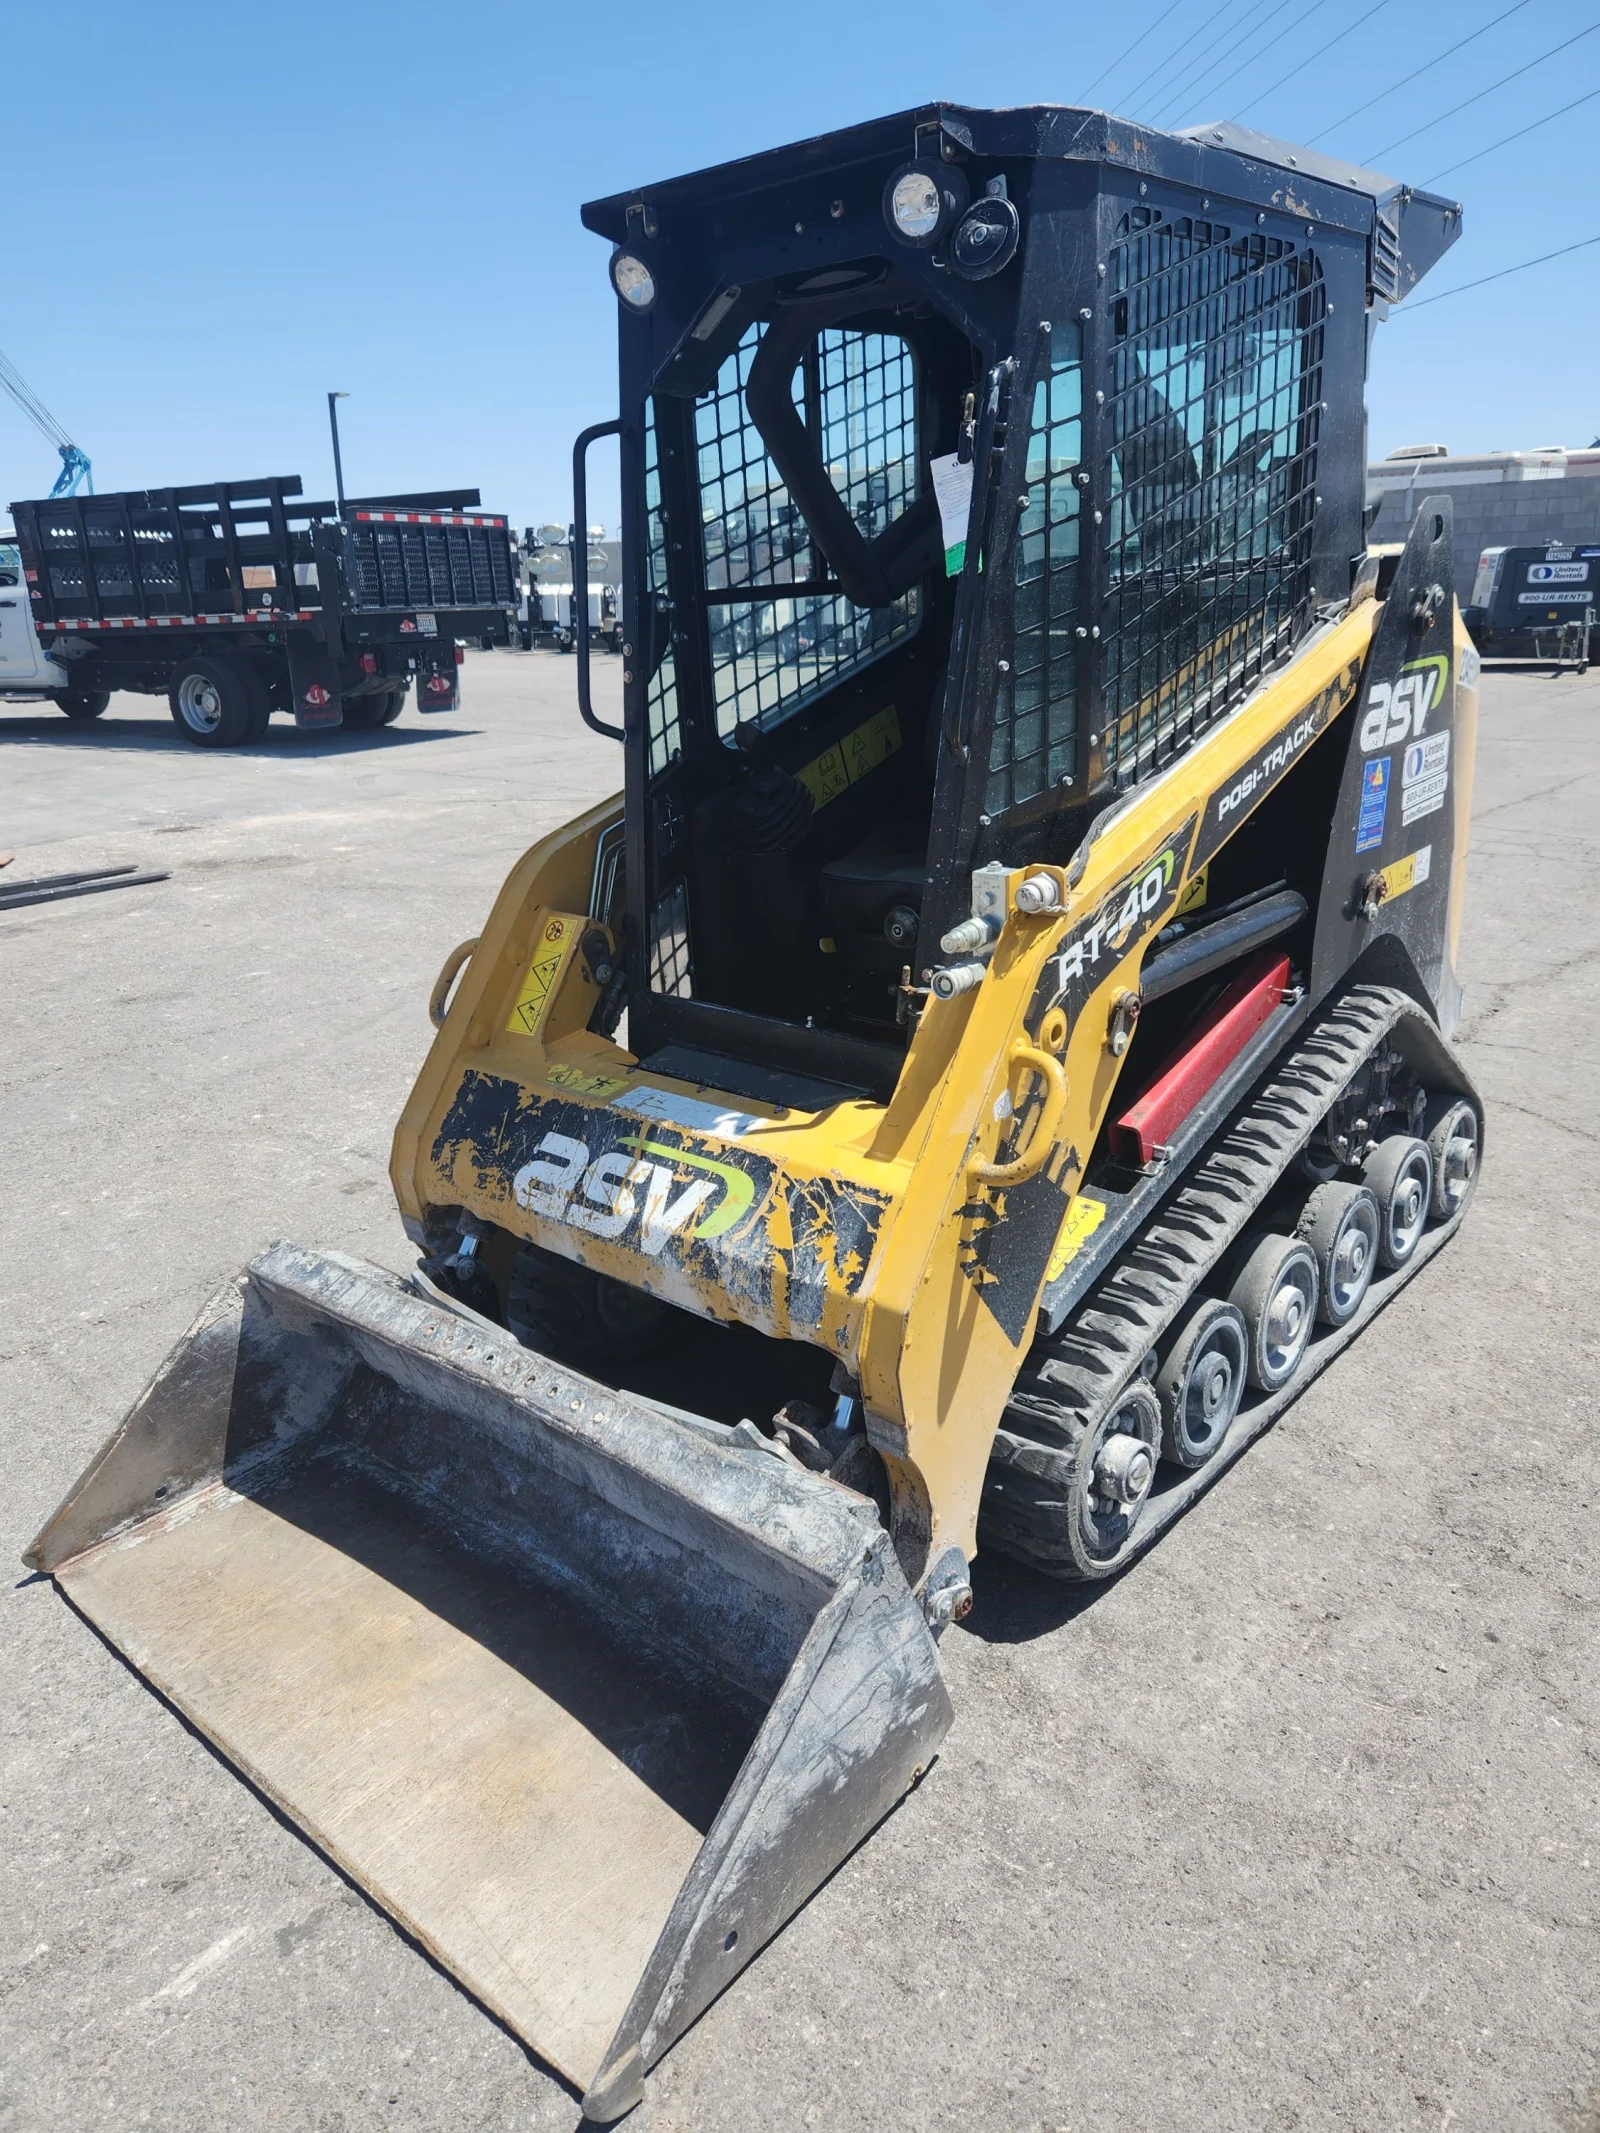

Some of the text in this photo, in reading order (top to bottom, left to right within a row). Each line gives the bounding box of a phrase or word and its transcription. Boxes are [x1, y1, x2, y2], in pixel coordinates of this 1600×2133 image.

[1553, 572, 1584, 580] Rentals
[1554, 565, 1583, 573] United
[1424, 737, 1446, 758] United
[1218, 713, 1315, 822] POSI-TRACK
[1423, 754, 1446, 773] Rentals
[1406, 777, 1445, 805] 800-UR-RENTS
[1058, 866, 1163, 994] RT-40
